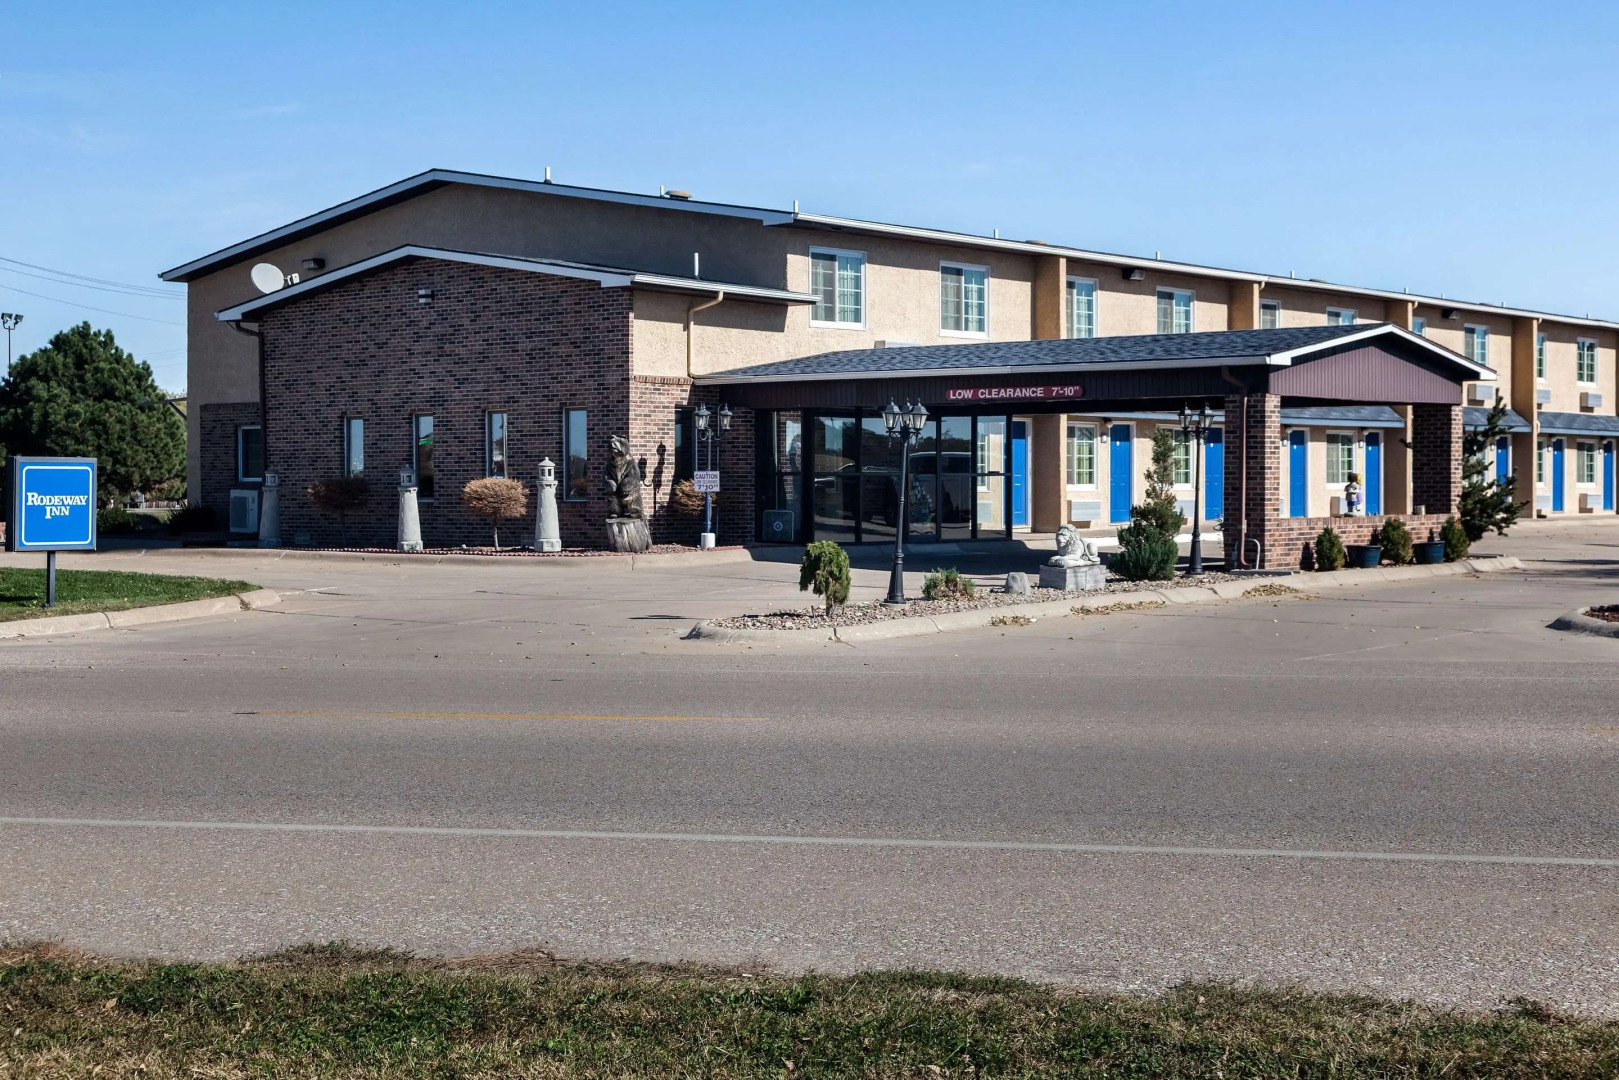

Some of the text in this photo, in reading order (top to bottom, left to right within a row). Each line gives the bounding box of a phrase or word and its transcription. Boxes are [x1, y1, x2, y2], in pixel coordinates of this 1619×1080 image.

[950, 389, 973, 399] LOW
[978, 387, 1044, 398] CLEARANCE
[26, 492, 88, 505] RODEWAY
[45, 506, 70, 519] INN
